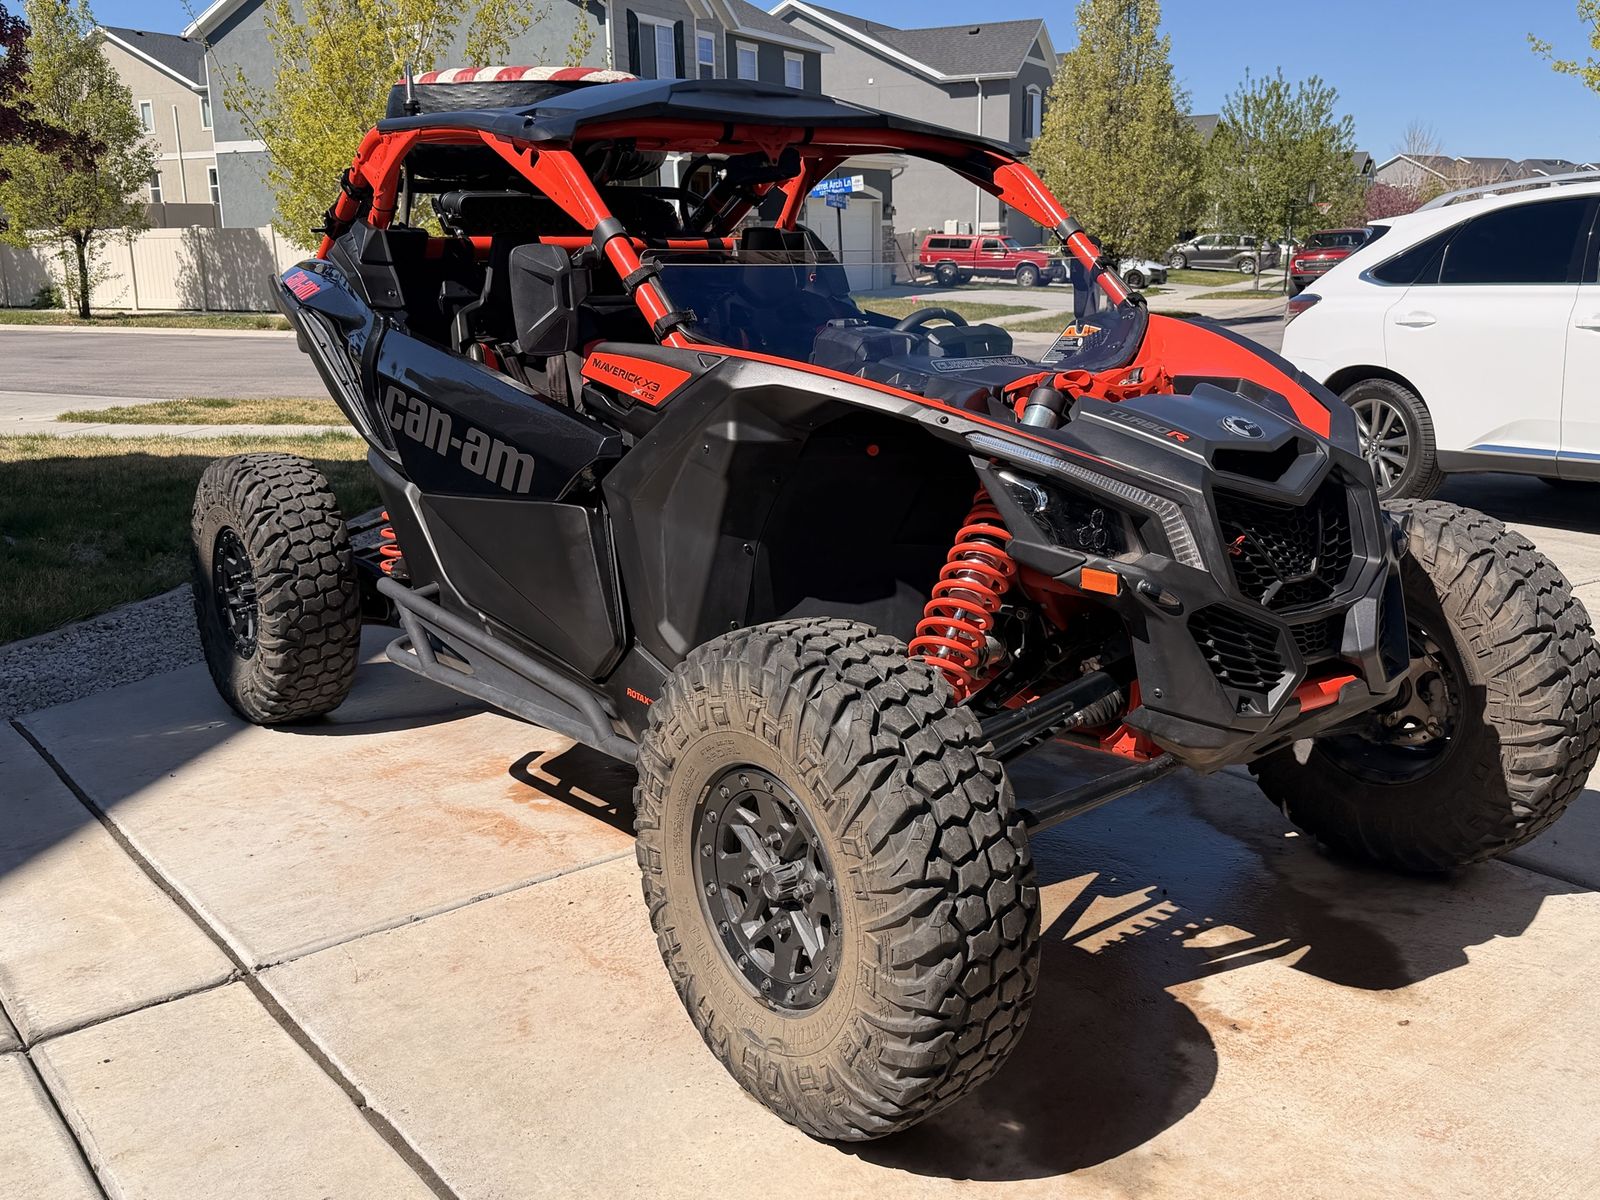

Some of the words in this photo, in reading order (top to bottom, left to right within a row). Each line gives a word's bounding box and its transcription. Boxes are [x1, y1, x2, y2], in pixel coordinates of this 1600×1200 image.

[829, 180, 843, 189] Arch
[844, 179, 852, 187] Ln
[592, 358, 642, 386] MAVERICK
[642, 378, 661, 393] X3
[1110, 409, 1171, 434] TURBO
[384, 385, 535, 494] can-am
[626, 687, 650, 706] ROTAX
